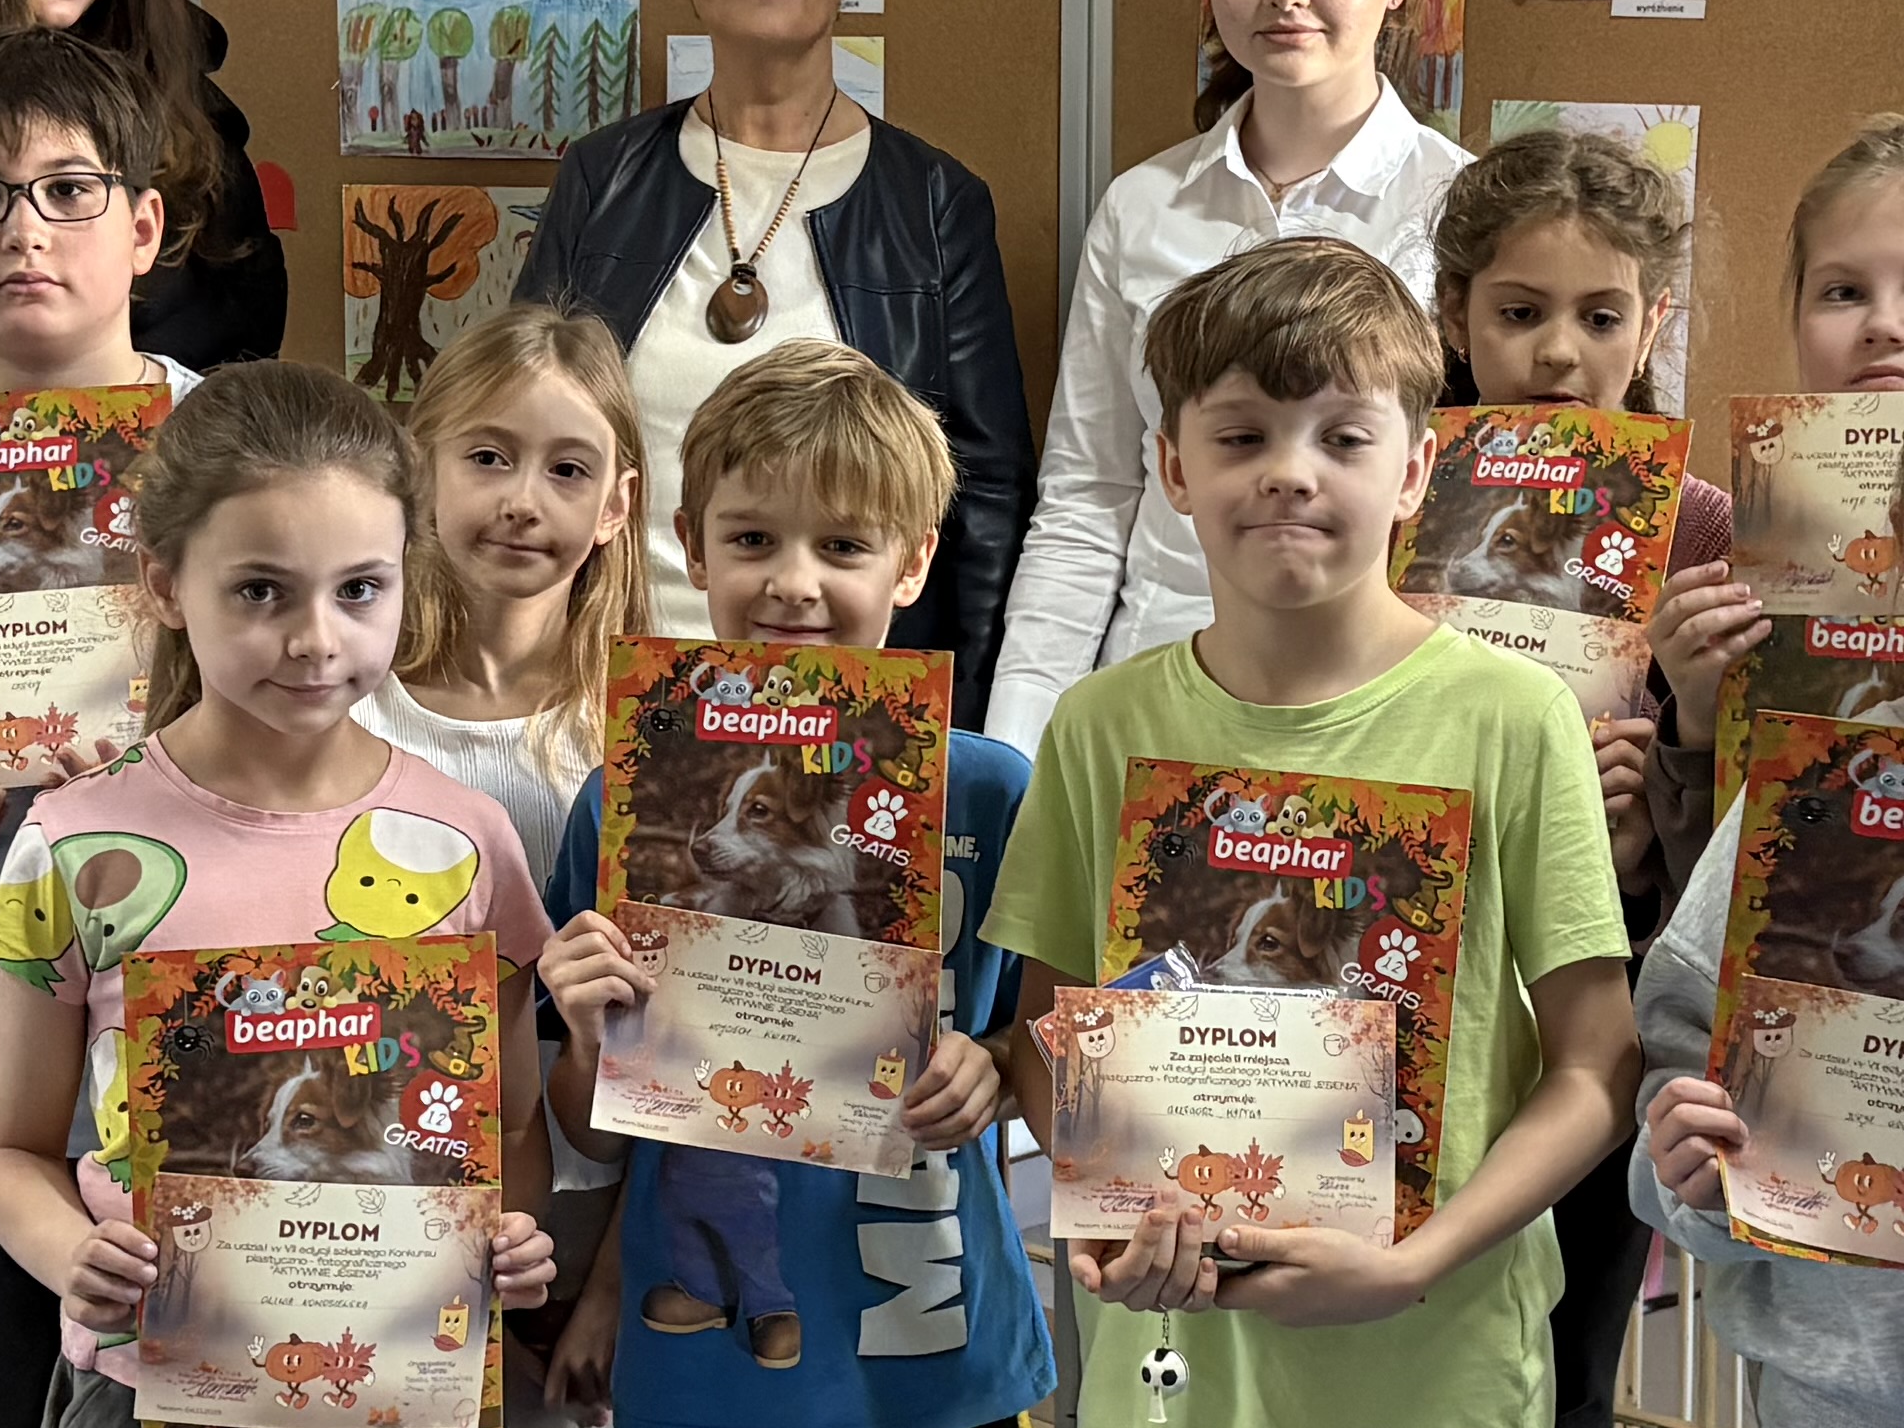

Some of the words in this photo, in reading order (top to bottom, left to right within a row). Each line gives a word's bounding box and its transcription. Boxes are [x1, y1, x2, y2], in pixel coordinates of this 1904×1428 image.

[1845, 427, 1902, 445] DYPL
[48, 458, 111, 492] KIDS
[1477, 455, 1580, 484] beaphar
[1549, 487, 1611, 518] KIDS
[1564, 557, 1633, 601] GRATIS
[703, 707, 830, 739] beaphar
[801, 743, 873, 775] KIDS
[870, 816, 891, 833] 12
[830, 823, 911, 866] GRATIS
[1214, 831, 1346, 871] beaphar
[1313, 875, 1387, 912] KIDS
[728, 954, 821, 985] DYPLOM
[1382, 955, 1403, 973] 12
[1340, 960, 1422, 1011] GRATIS
[232, 1010, 373, 1047] beaphar
[1179, 1026, 1277, 1048] DYPLOM
[344, 1031, 422, 1076] KIDS
[1169, 1051, 1186, 1061] Za
[424, 1110, 447, 1127] 12
[384, 1123, 469, 1159] GRATIS
[279, 1220, 380, 1242] DYPLOM
[216, 1240, 231, 1250] Za
[299, 1245, 331, 1258] edycji
